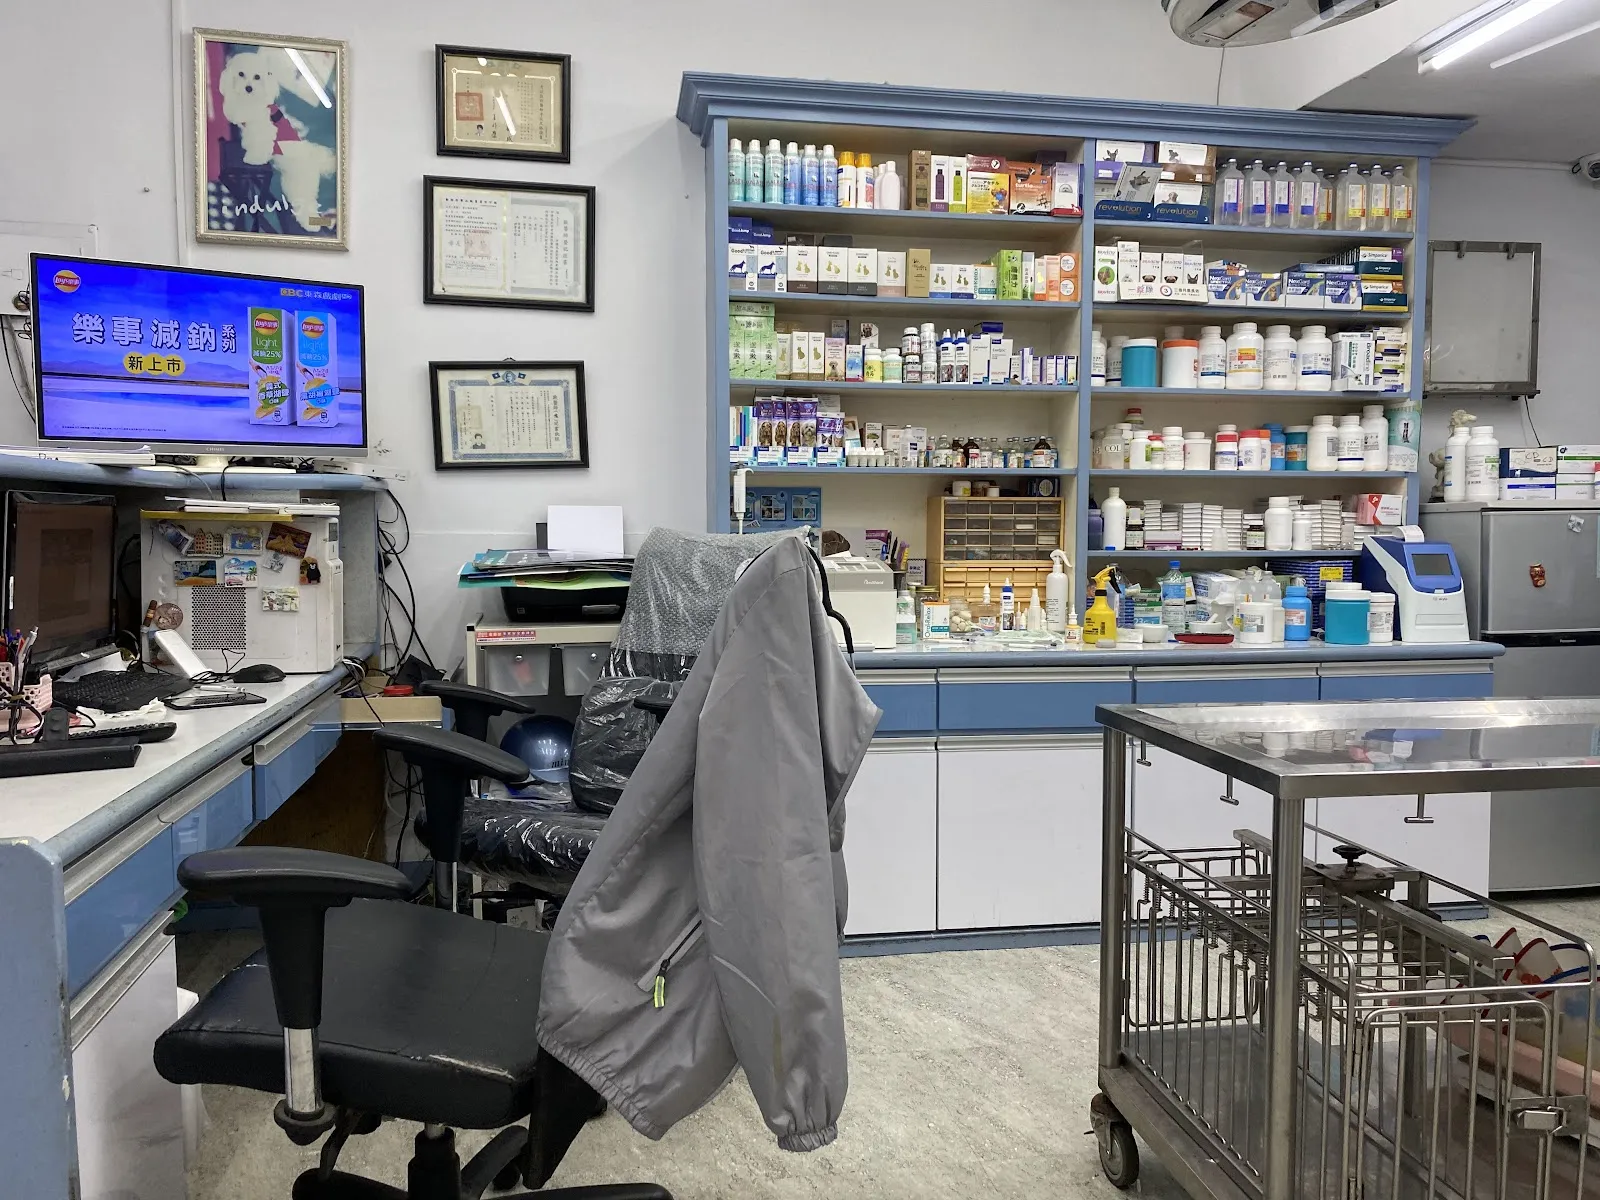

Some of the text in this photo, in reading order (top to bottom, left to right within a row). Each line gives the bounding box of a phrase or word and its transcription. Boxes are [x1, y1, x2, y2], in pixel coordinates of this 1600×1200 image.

[1099, 203, 1142, 212] revolution
[1156, 207, 1199, 216] revolution
[72, 313, 237, 353] 樂事減鈉 系列
[255, 337, 278, 349] light
[128, 355, 182, 373] 新上市
